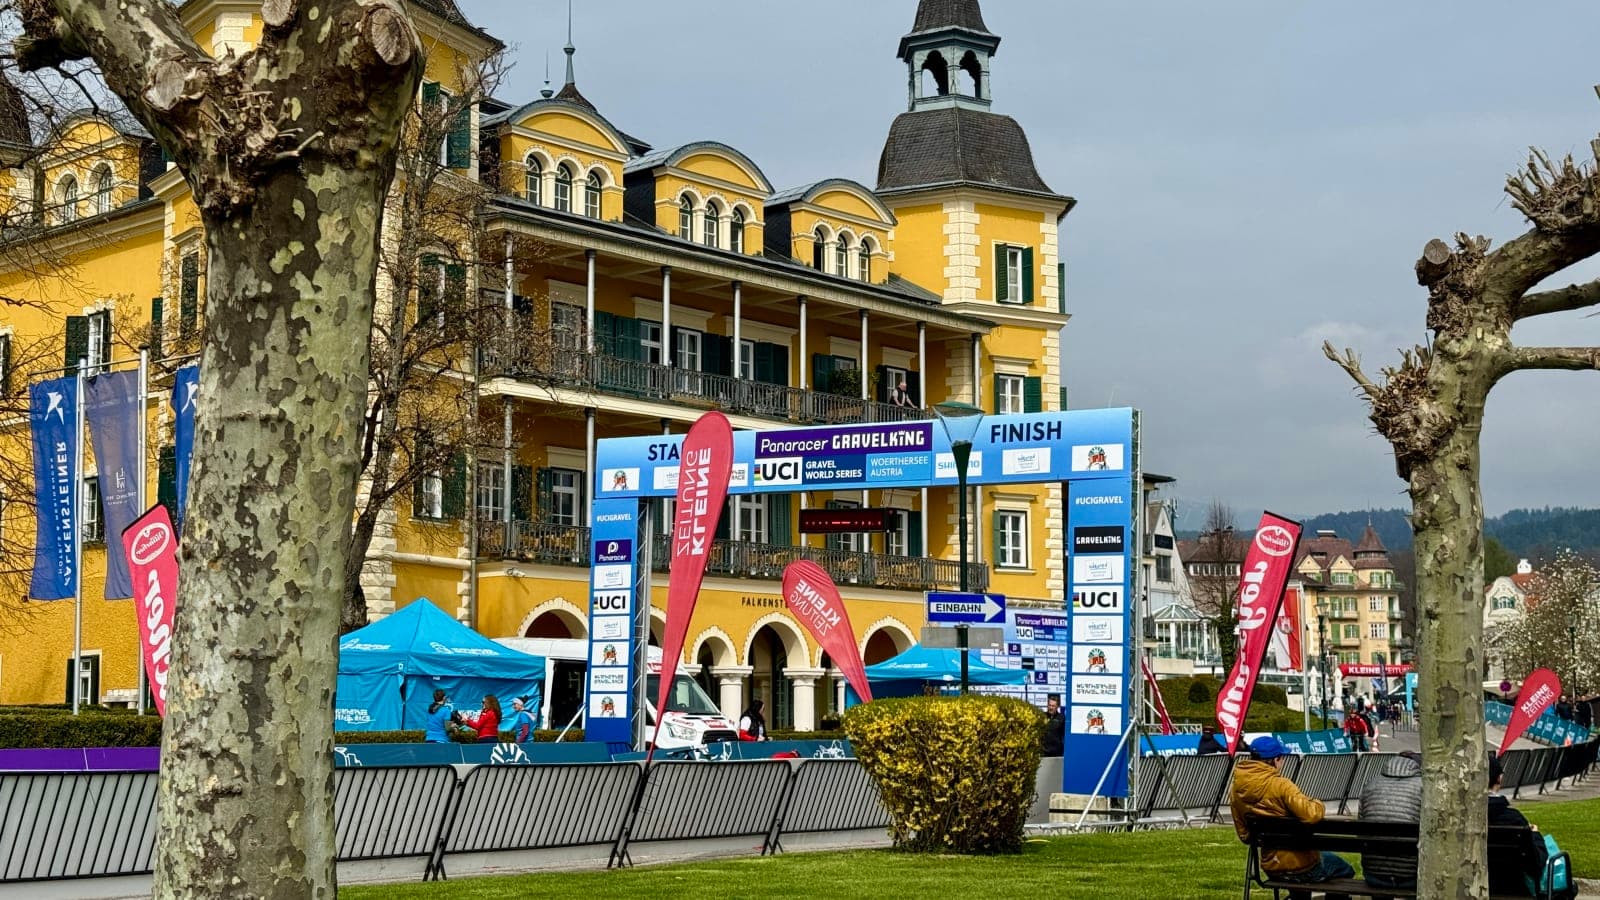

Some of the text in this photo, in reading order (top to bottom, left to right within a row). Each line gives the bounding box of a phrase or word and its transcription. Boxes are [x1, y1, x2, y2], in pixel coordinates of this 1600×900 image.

[991, 421, 1062, 443] FINISH
[761, 430, 925, 453] Panaracer GRAVELKING
[648, 443, 680, 461] STA
[806, 460, 837, 469] GRAVEL
[870, 456, 929, 467] WOERTHERSEE
[761, 462, 799, 481] UCI
[805, 469, 862, 479] WORLD SERIES
[870, 468, 903, 477] AUSTRIA
[1075, 496, 1123, 505] #UCIGRAVEL
[599, 595, 626, 610] UCI
[741, 597, 788, 608] FALKENST
[1081, 591, 1117, 608] UCI
[935, 603, 982, 613] EINBAHN
[1348, 667, 1380, 675] KLEINE
[1521, 683, 1549, 712] KLEINE
[1525, 690, 1554, 718] ZEITUNG
